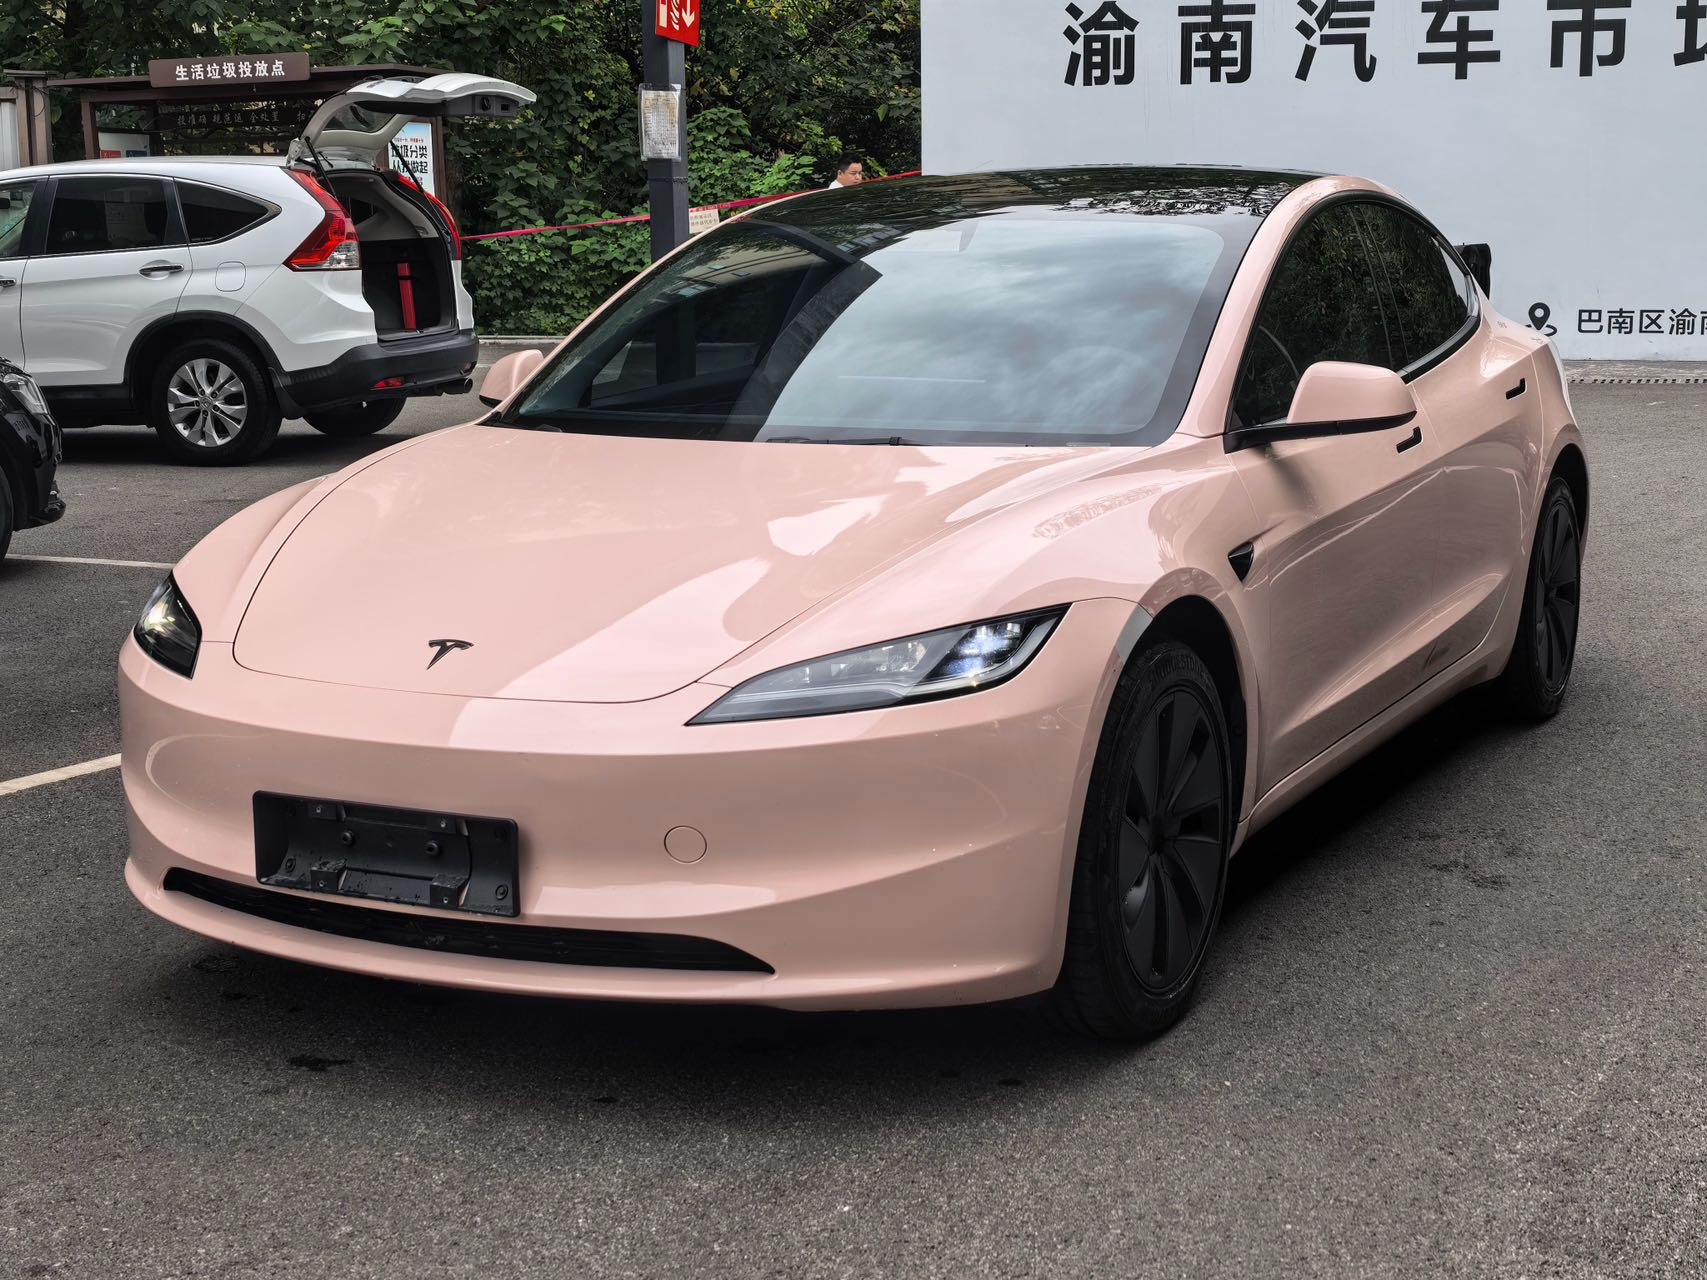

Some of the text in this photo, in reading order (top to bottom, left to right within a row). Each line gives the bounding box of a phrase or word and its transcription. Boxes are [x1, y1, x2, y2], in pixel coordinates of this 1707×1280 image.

[175, 59, 285, 81] 生活垃圾投放点
[1577, 307, 1707, 336] 巴南区渝
